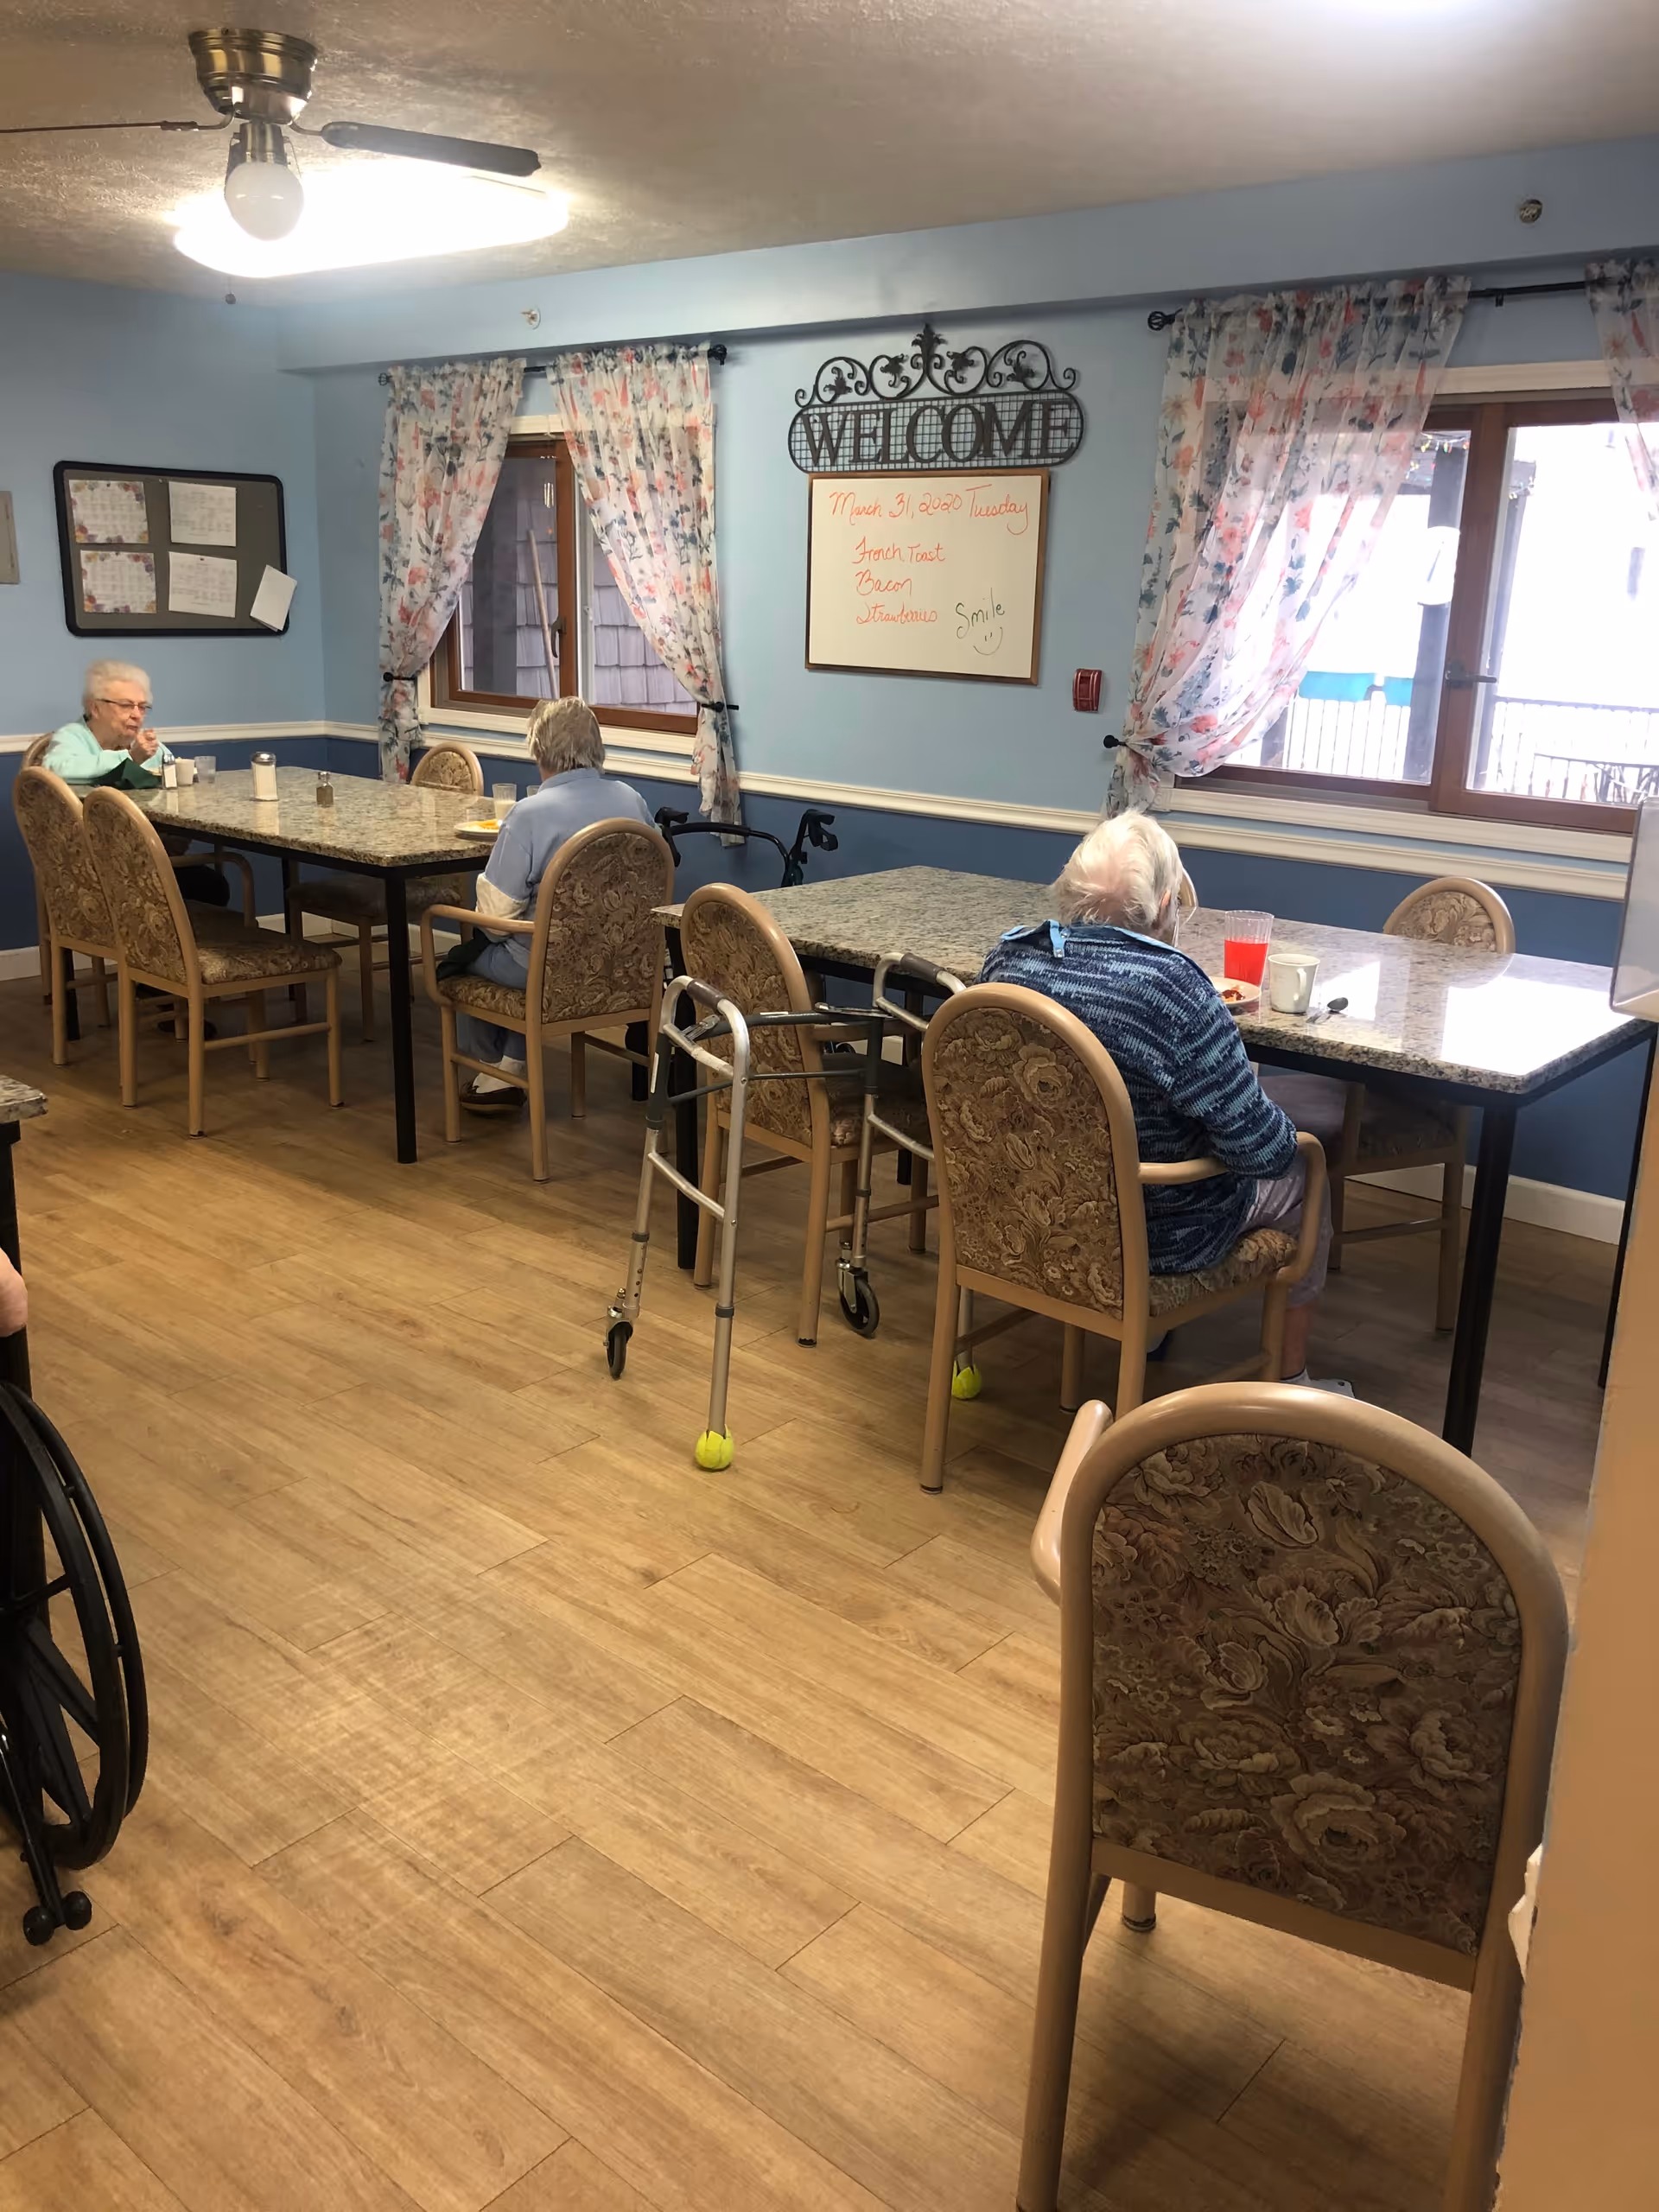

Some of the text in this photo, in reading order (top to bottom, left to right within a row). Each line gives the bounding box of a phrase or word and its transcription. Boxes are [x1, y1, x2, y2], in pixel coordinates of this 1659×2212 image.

[801, 399, 1075, 467] WELCOME
[830, 484, 1028, 535] March 31, 2020 Tuesday
[852, 536, 945, 563] French Toast
[855, 569, 912, 596] Bacon
[856, 602, 938, 624] Strawberries
[956, 587, 1006, 639] Smile
